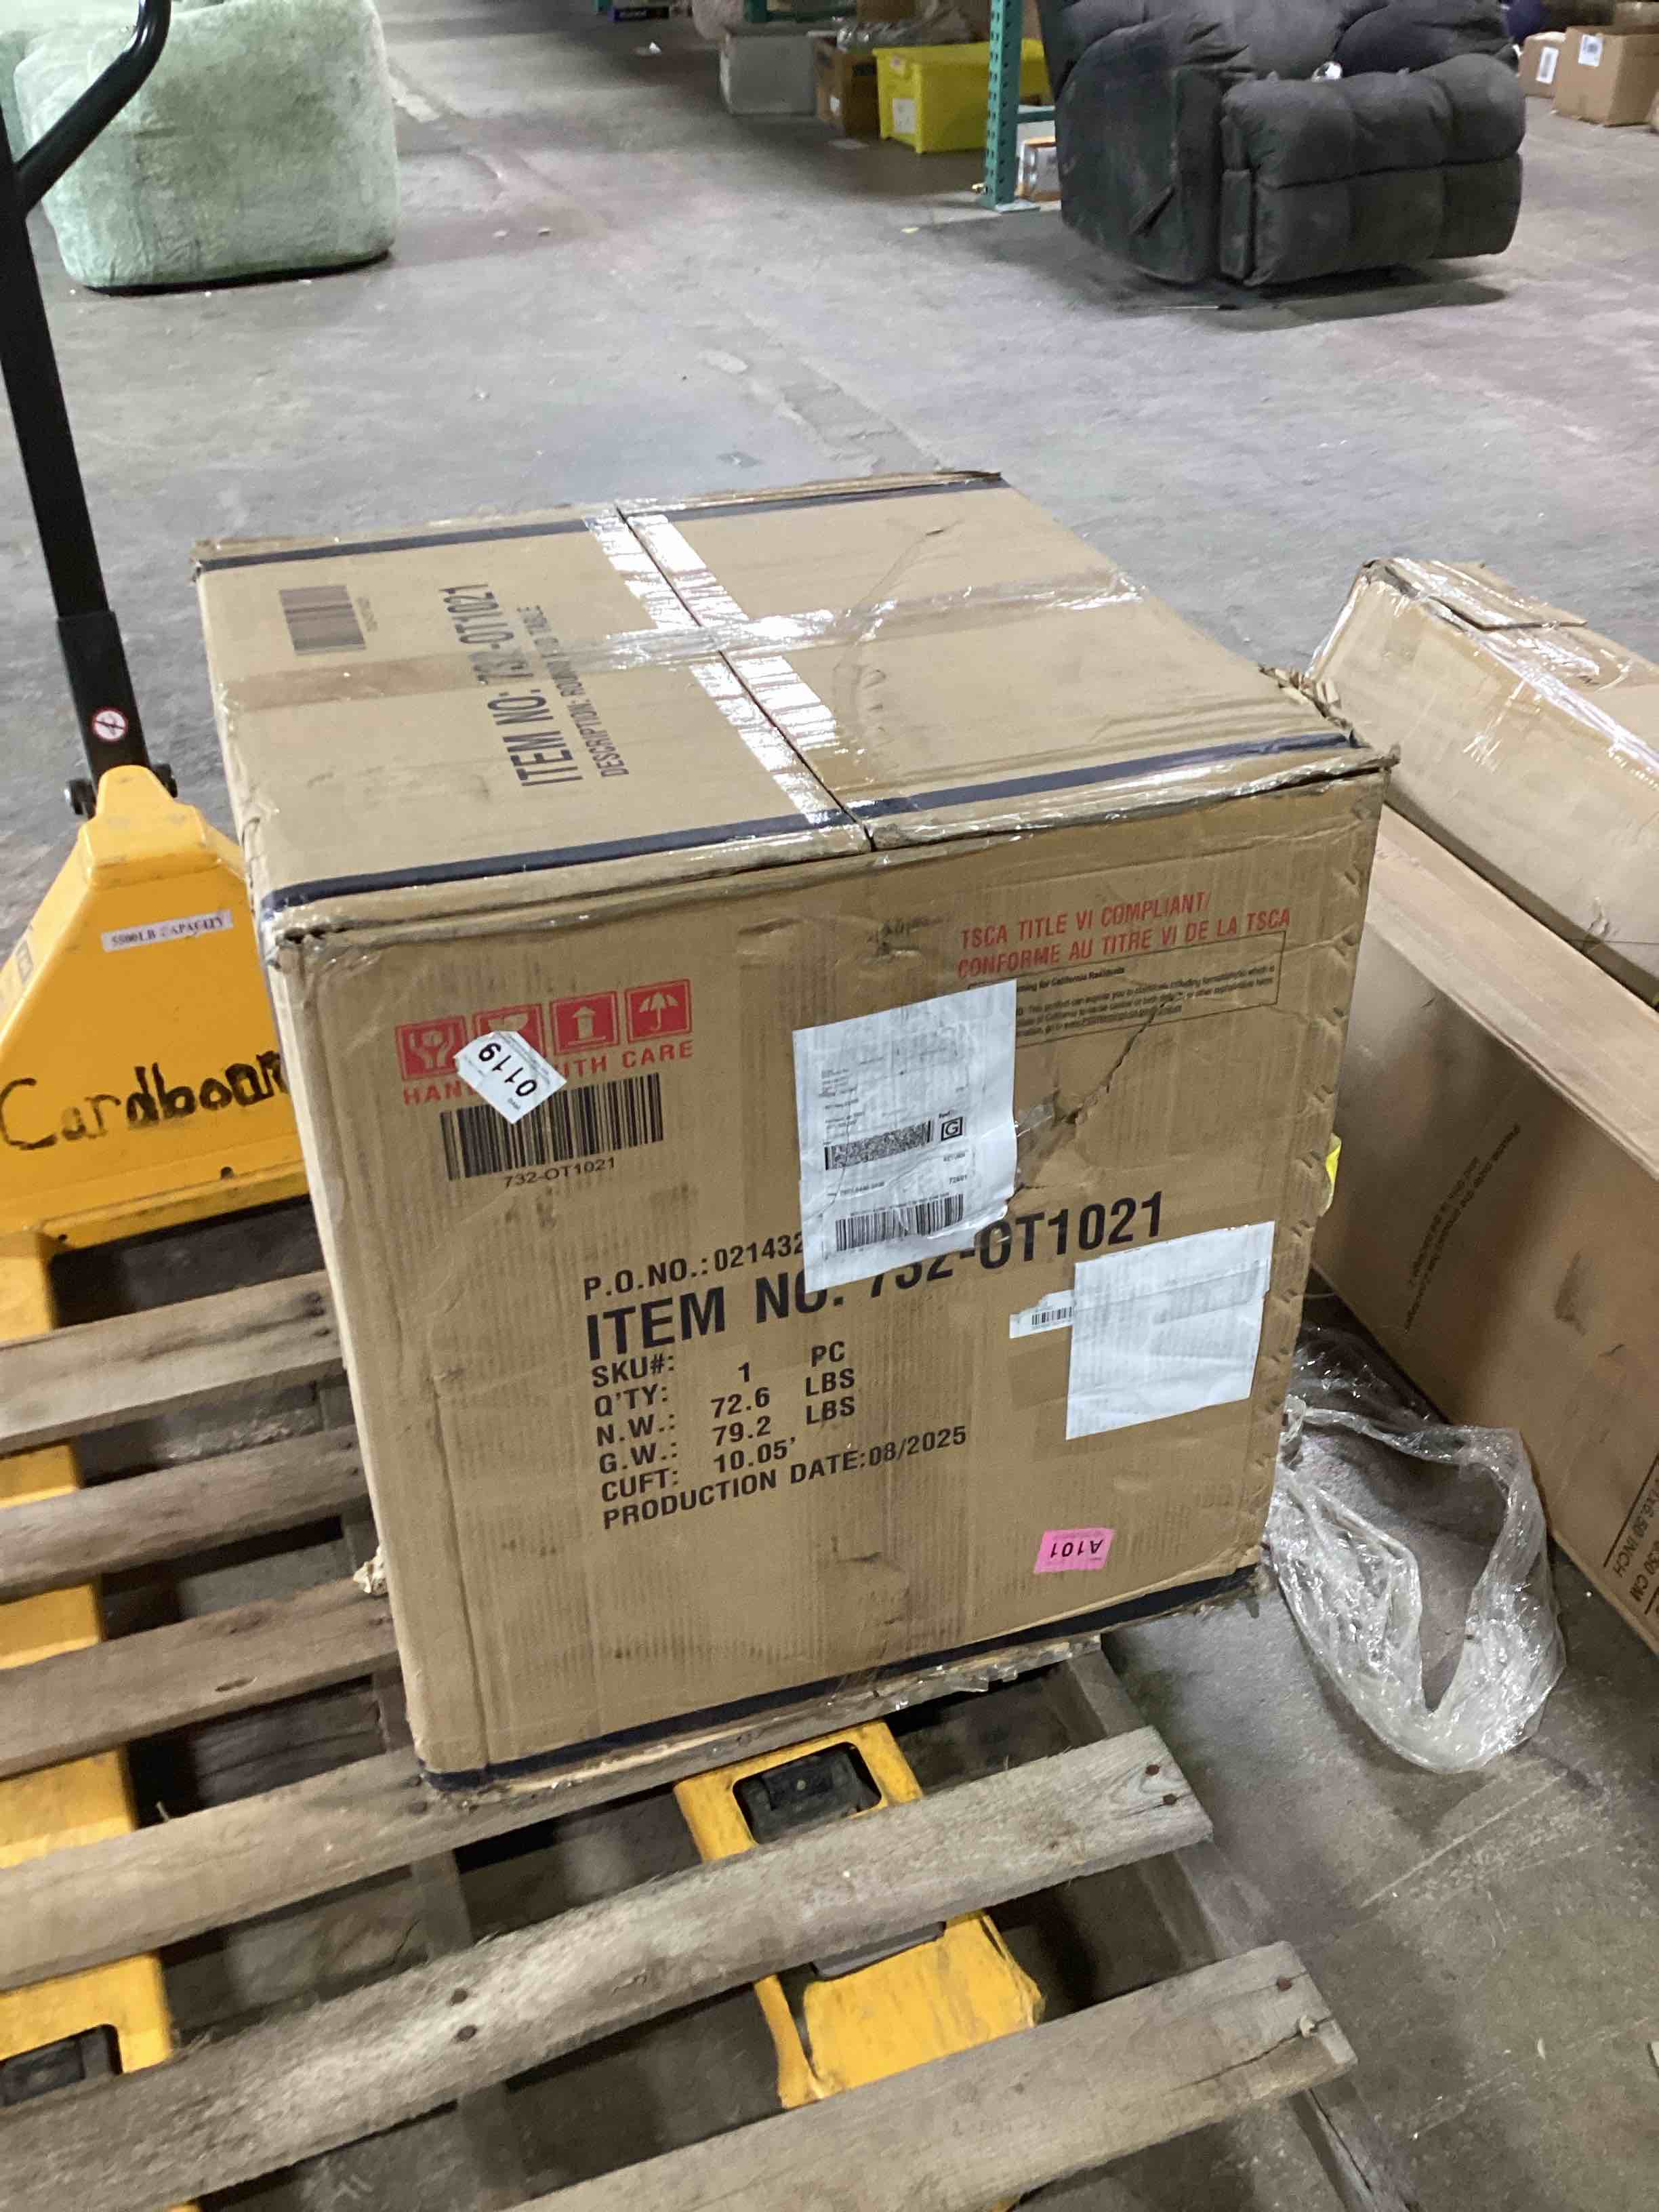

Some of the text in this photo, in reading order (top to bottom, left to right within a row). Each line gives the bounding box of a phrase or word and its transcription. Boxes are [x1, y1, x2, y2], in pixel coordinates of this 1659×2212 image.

[487, 689, 554, 726] NO:
[502, 730, 583, 786] ITEM
[567, 699, 630, 777] DESCRIPTION:
[958, 907, 1291, 977] CONFORME AU TITRE VI DE LA TSCA
[961, 924, 1008, 949] TSCA
[1017, 914, 1068, 941] TITLE
[1076, 911, 1094, 931] VI
[403, 1080, 477, 1106] HAN
[555, 1055, 608, 1079] ITH
[621, 1040, 695, 1069] CARE
[478, 1042, 537, 1097] 0119
[0, 1050, 290, 1151] Cardboar
[945, 1120, 959, 1136] G
[504, 1155, 615, 1188] 732-OT1021
[587, 1286, 725, 1361] ITEM
[591, 1353, 674, 1388] SKU#:
[594, 1340, 846, 1417] Q'TY: 1 PC
[596, 1368, 855, 1447] N.W.: 72.6 LBS
[599, 1396, 855, 1475] G.W.: 79.2 LBS
[602, 1468, 678, 1502] CUFT:
[602, 1469, 777, 1530] PRODUCTION
[1050, 1539, 1104, 1558] A101
[1613, 1535, 1639, 1578] INCH
[1630, 1574, 1649, 1602] CM
